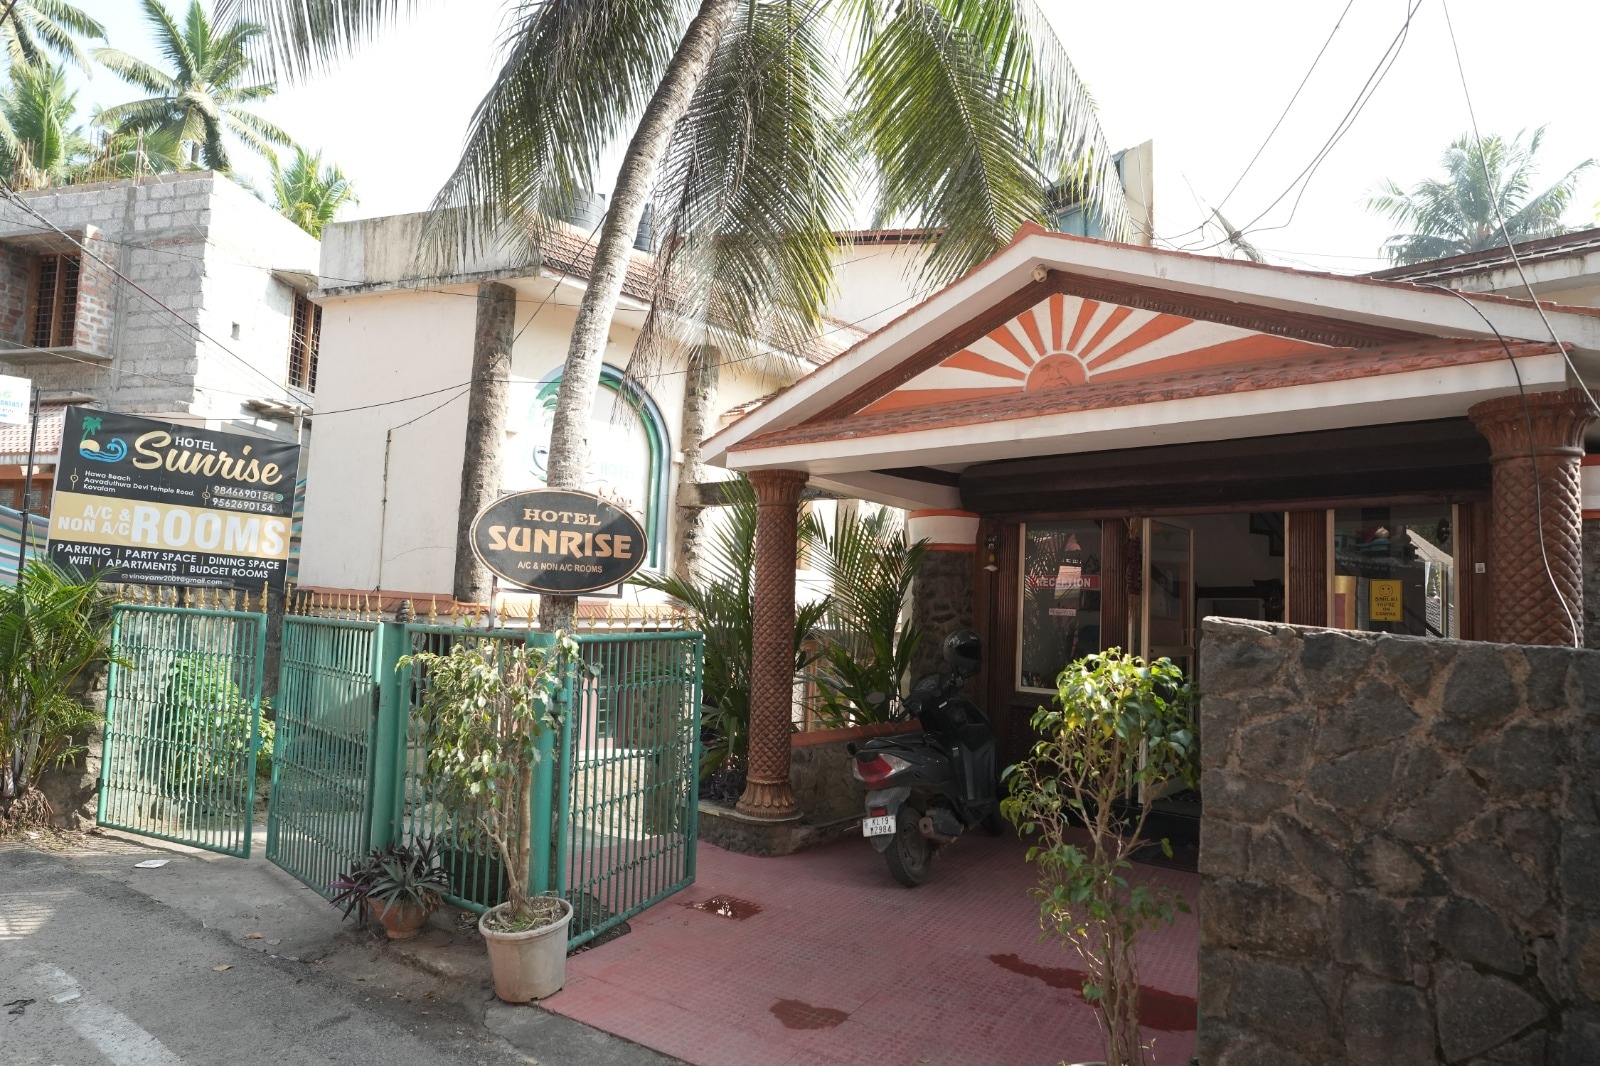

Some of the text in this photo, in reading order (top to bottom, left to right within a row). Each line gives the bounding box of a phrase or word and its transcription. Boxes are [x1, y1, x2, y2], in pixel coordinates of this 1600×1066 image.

[175, 436, 217, 452] HOTEL
[132, 430, 282, 486] Sunrise
[84, 470, 131, 481] Hawa Beach
[83, 483, 116, 493] Kovalam
[150, 485, 175, 494] Temple
[213, 485, 275, 501] 9846690154
[83, 504, 131, 522] A/C &
[212, 497, 273, 512] 9562690154
[523, 508, 602, 526] HOTEL
[57, 516, 130, 536] NON A/C
[130, 505, 286, 556] ROOMS
[488, 525, 633, 559] SUNRISE
[57, 543, 280, 570] PARKING PARTY SPACE DINING SPACE
[69, 555, 269, 579] WiFi APARTMENTS BUDGET ROOMS
[517, 561, 603, 573] A/C & NON A/C ROOMS
[1037, 577, 1091, 588] RECEPTION
